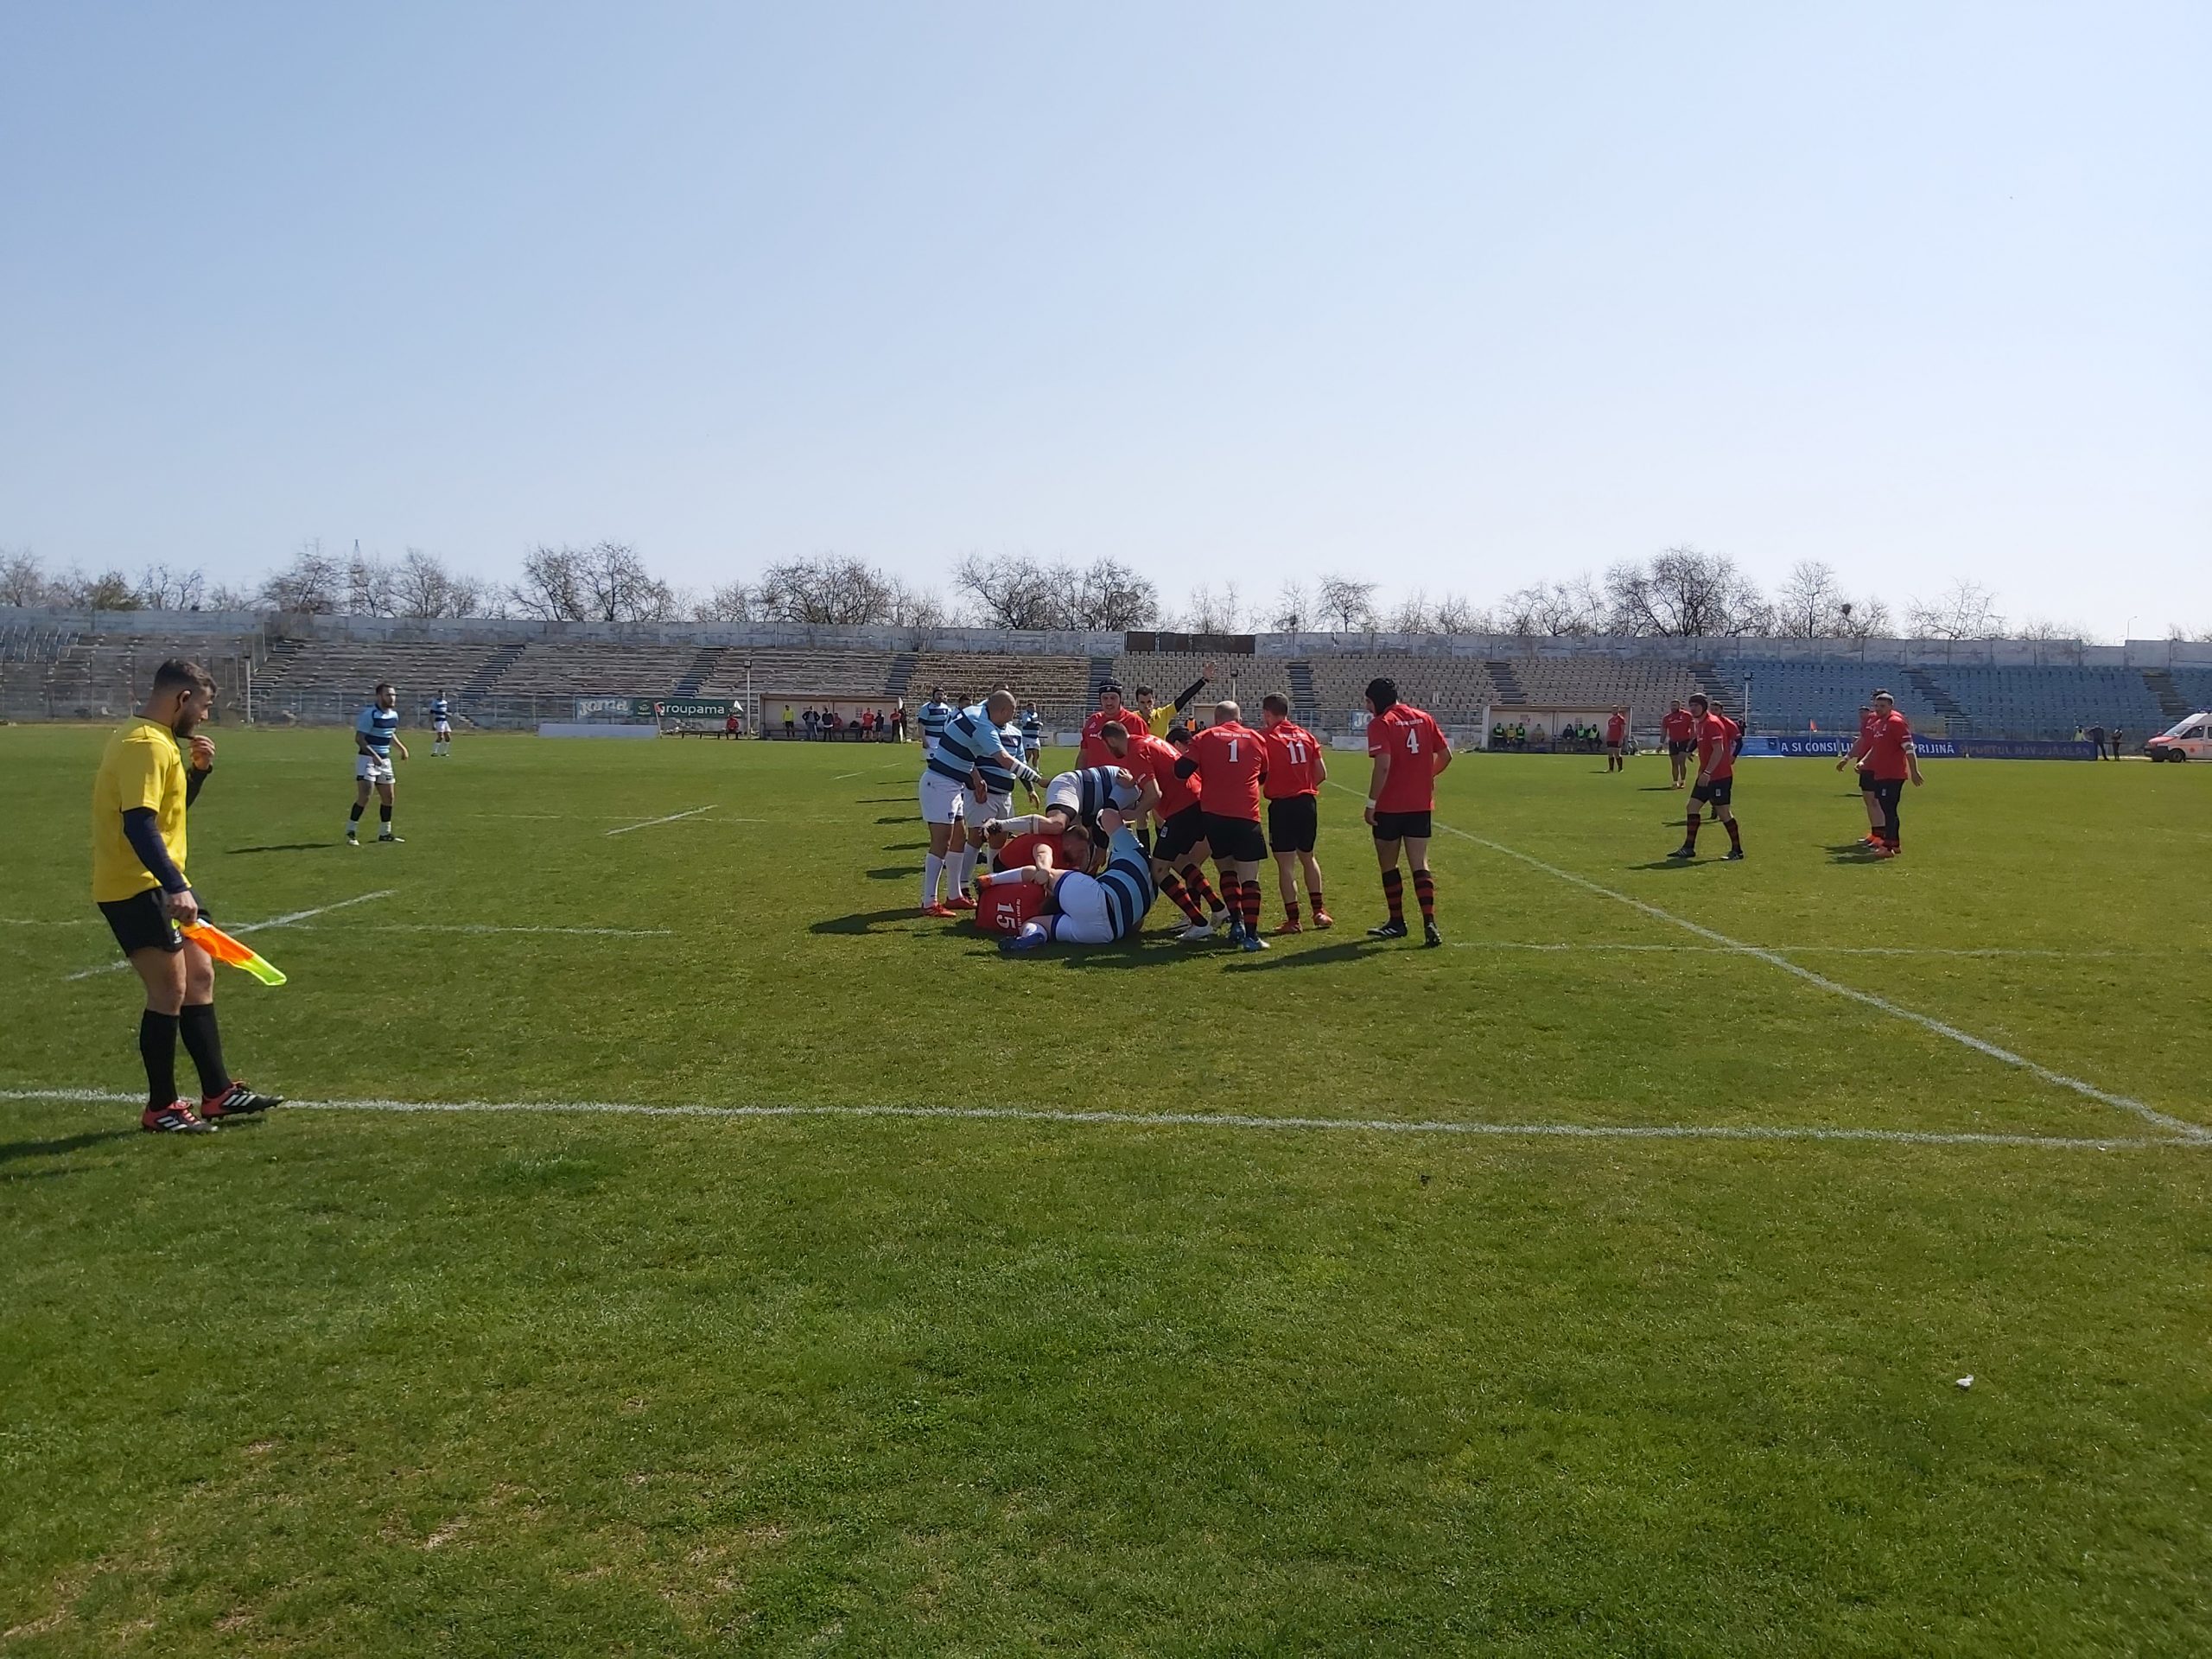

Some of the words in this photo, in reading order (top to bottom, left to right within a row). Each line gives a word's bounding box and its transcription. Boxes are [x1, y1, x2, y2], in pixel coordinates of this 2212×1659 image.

[655, 701, 725, 716] Groupama
[1228, 739, 1238, 763] 1
[1286, 739, 1307, 765] 11
[1406, 728, 1420, 754] 4
[996, 902, 1017, 929] 15
